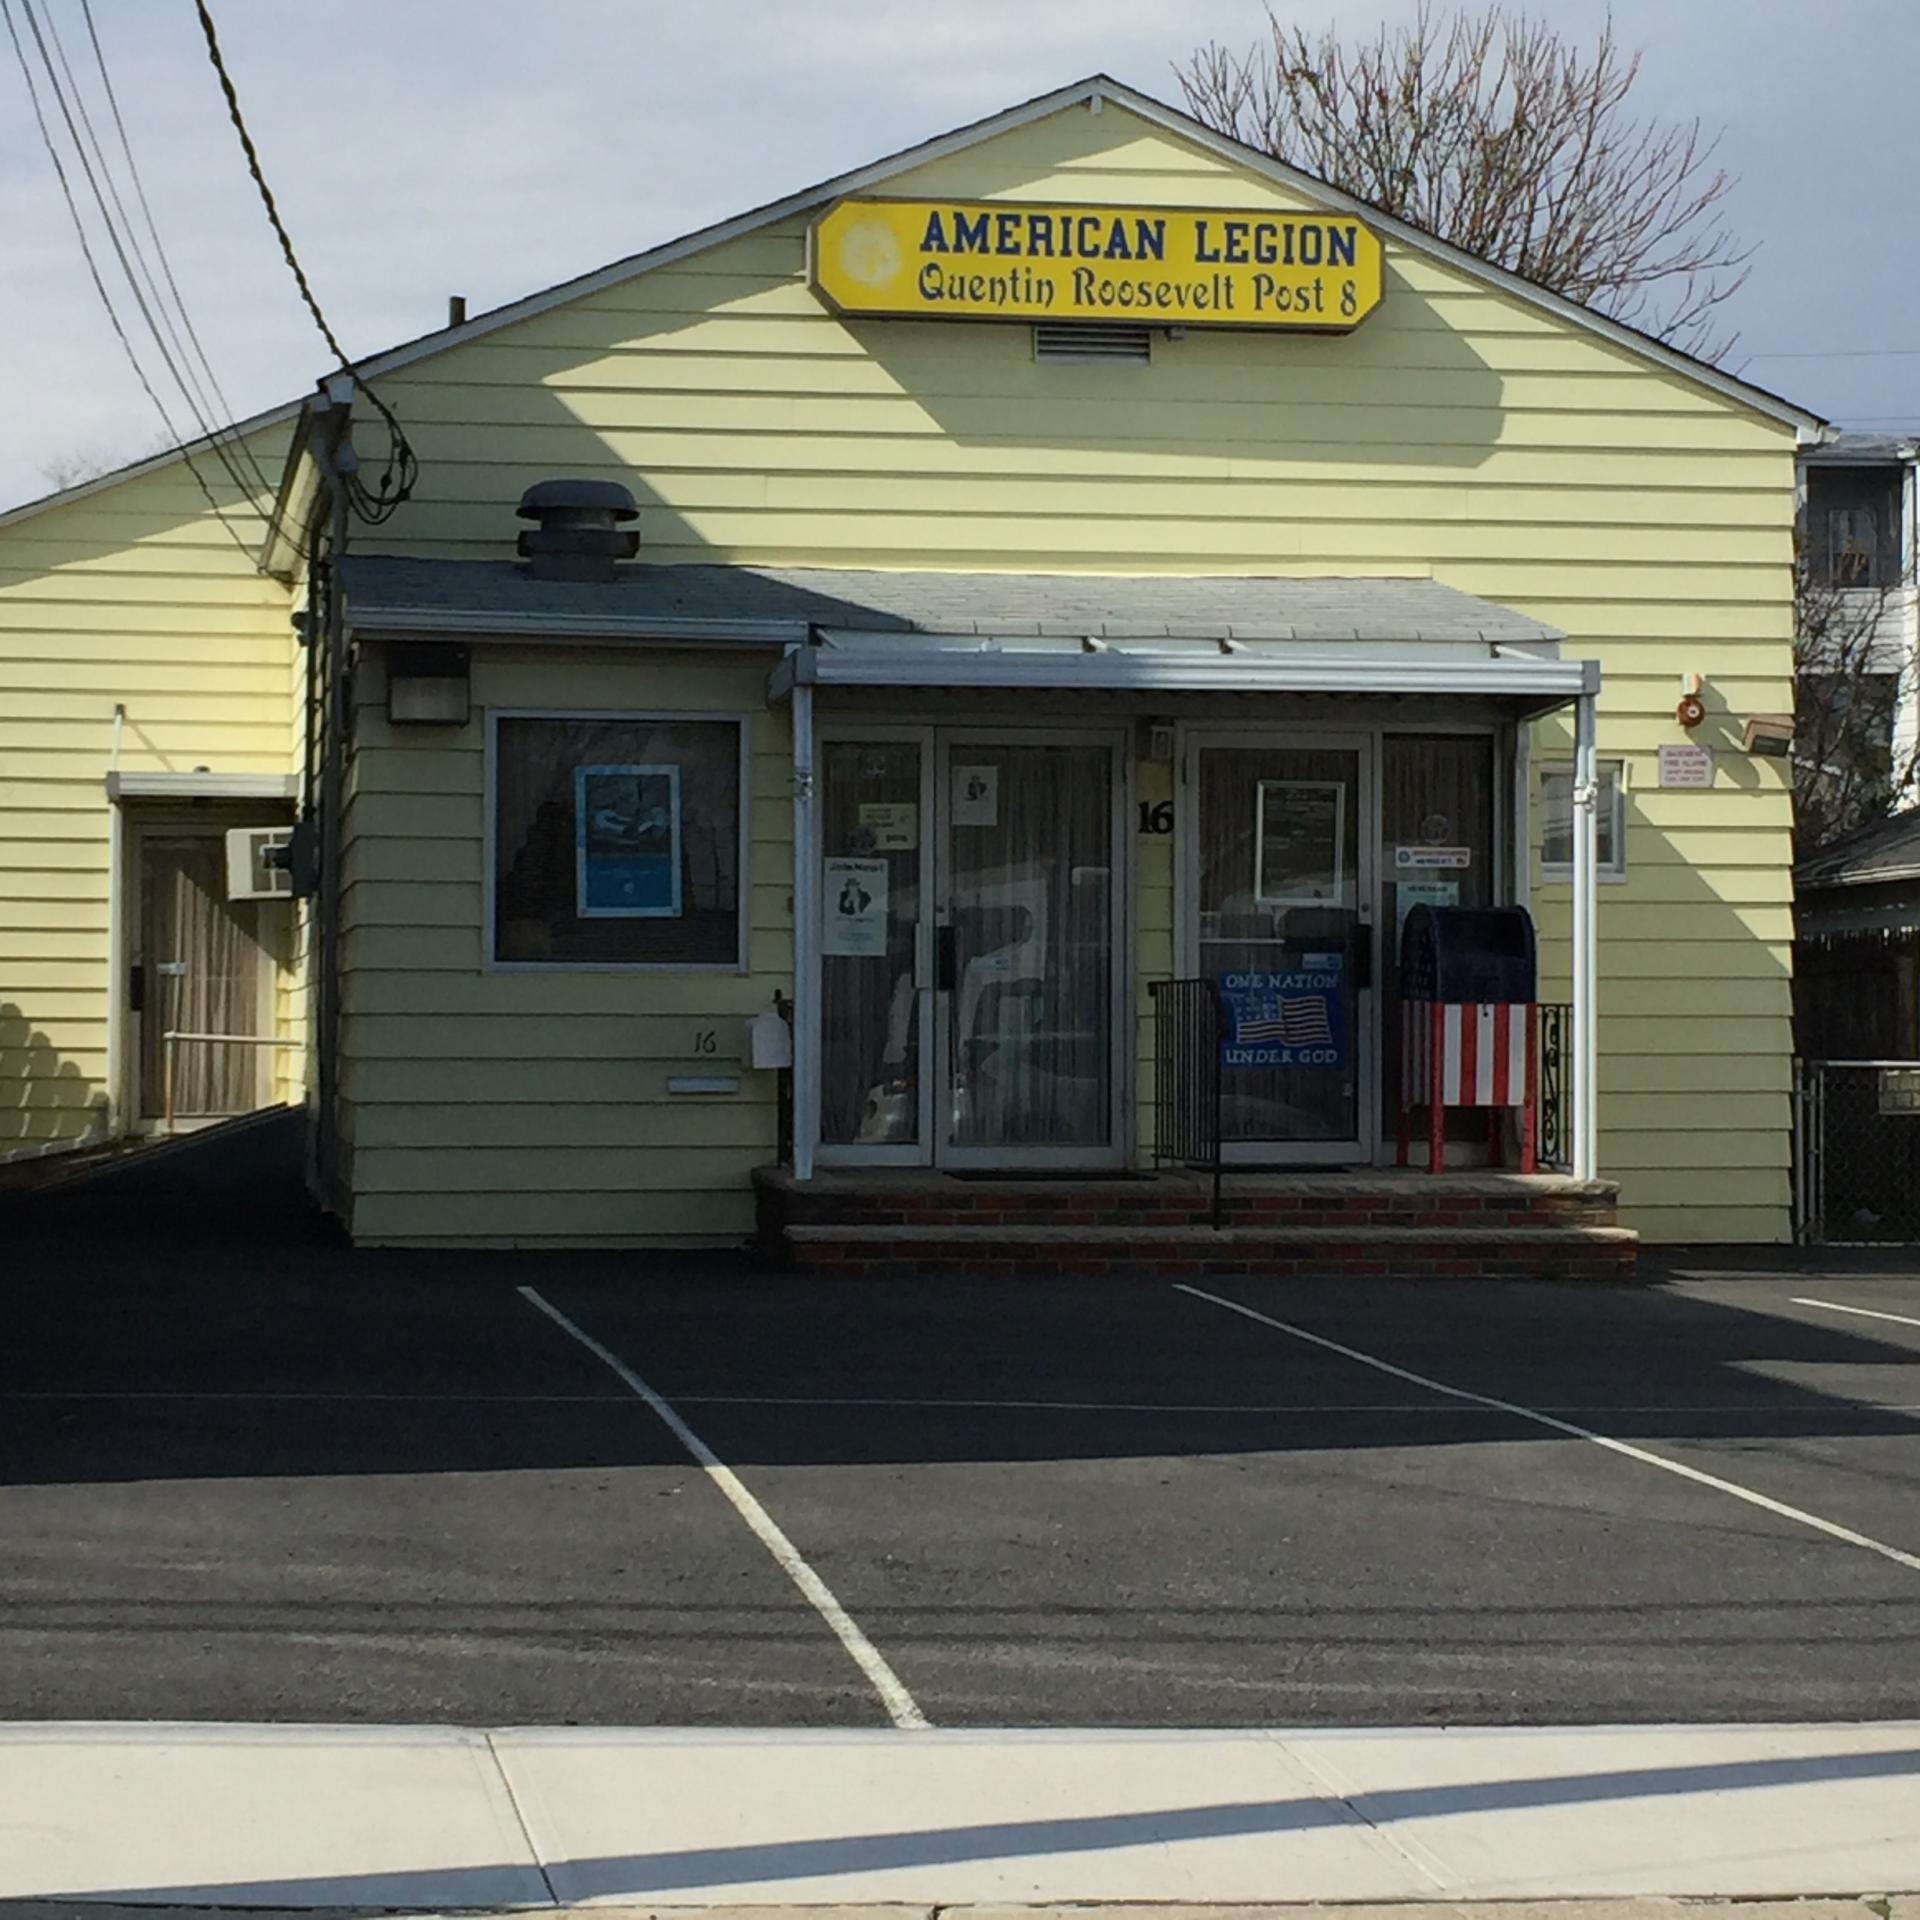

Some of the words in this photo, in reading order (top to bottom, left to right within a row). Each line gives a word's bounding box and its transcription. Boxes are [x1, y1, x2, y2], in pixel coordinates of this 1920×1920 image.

[919, 210, 1166, 261] AMERICAN
[1195, 220, 1357, 267] LEGION
[918, 262, 1055, 309] Quentin
[1072, 266, 1235, 310] Roosevelt
[1252, 273, 1324, 313] Post
[1339, 279, 1357, 317] 8
[1138, 801, 1174, 834] 16
[1225, 973, 1264, 989] ONE
[1268, 973, 1339, 989] NATION
[694, 1031, 717, 1054] 16
[1225, 1048, 1293, 1064] UNDER
[1298, 1048, 1338, 1064] GOD
